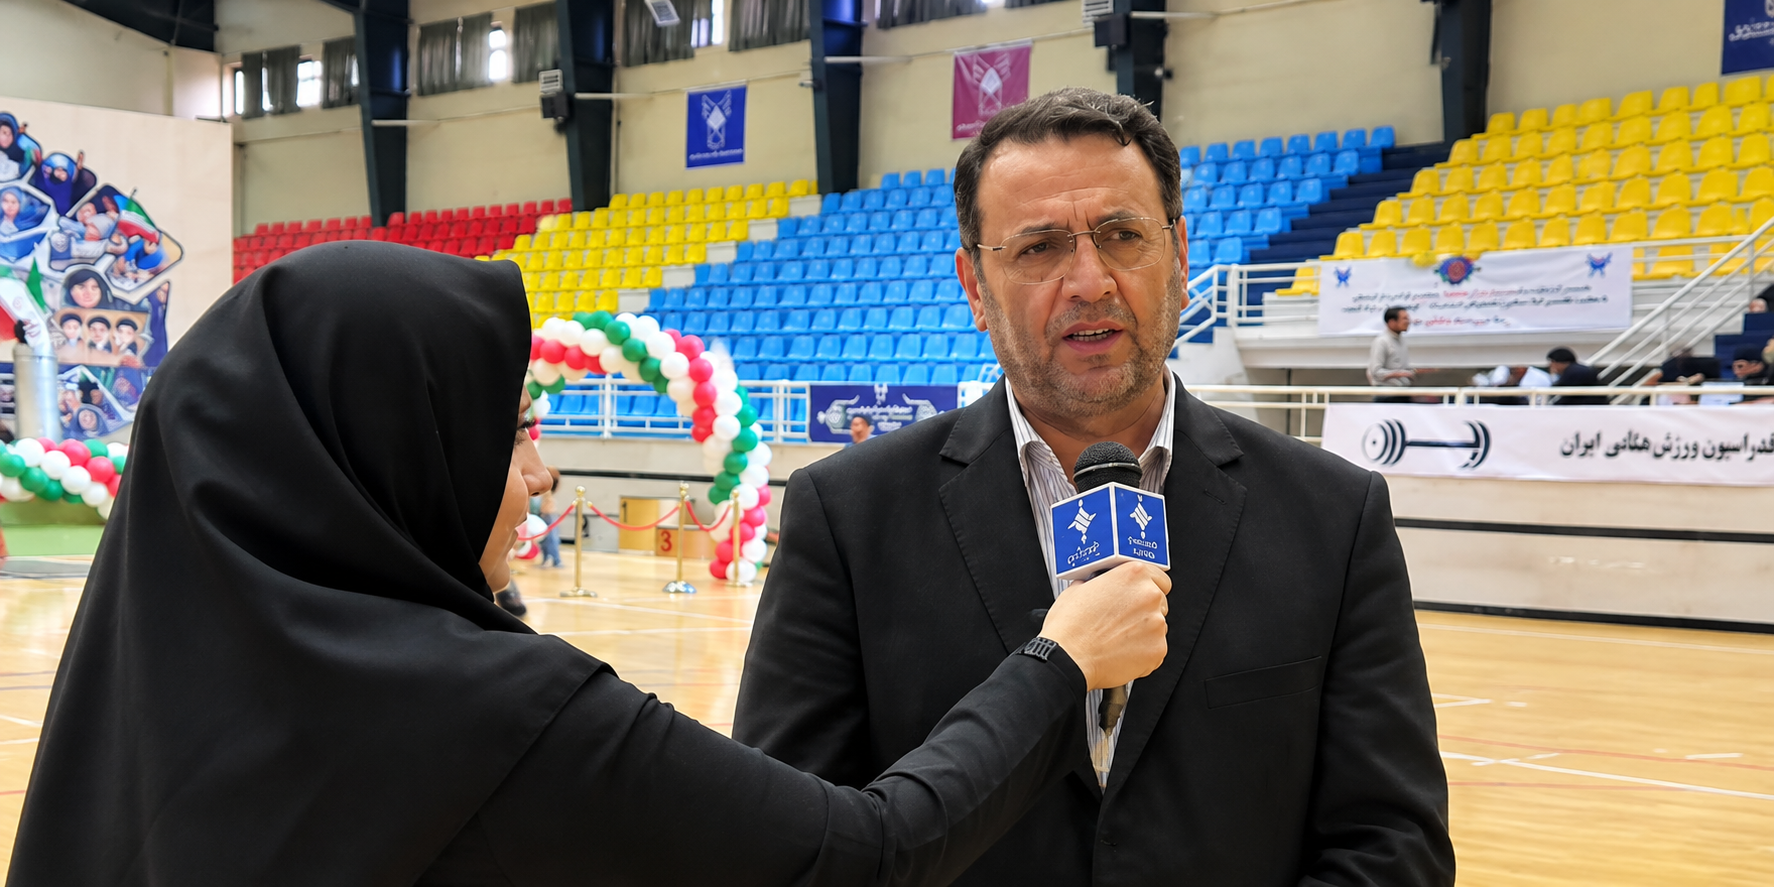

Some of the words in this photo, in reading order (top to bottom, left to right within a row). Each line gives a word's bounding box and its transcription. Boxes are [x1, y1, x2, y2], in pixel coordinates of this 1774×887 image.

[1561, 431, 1600, 457] ایران
[1653, 432, 1698, 459] ورزش
[621, 501, 627, 523] 1
[660, 530, 673, 553] 3
